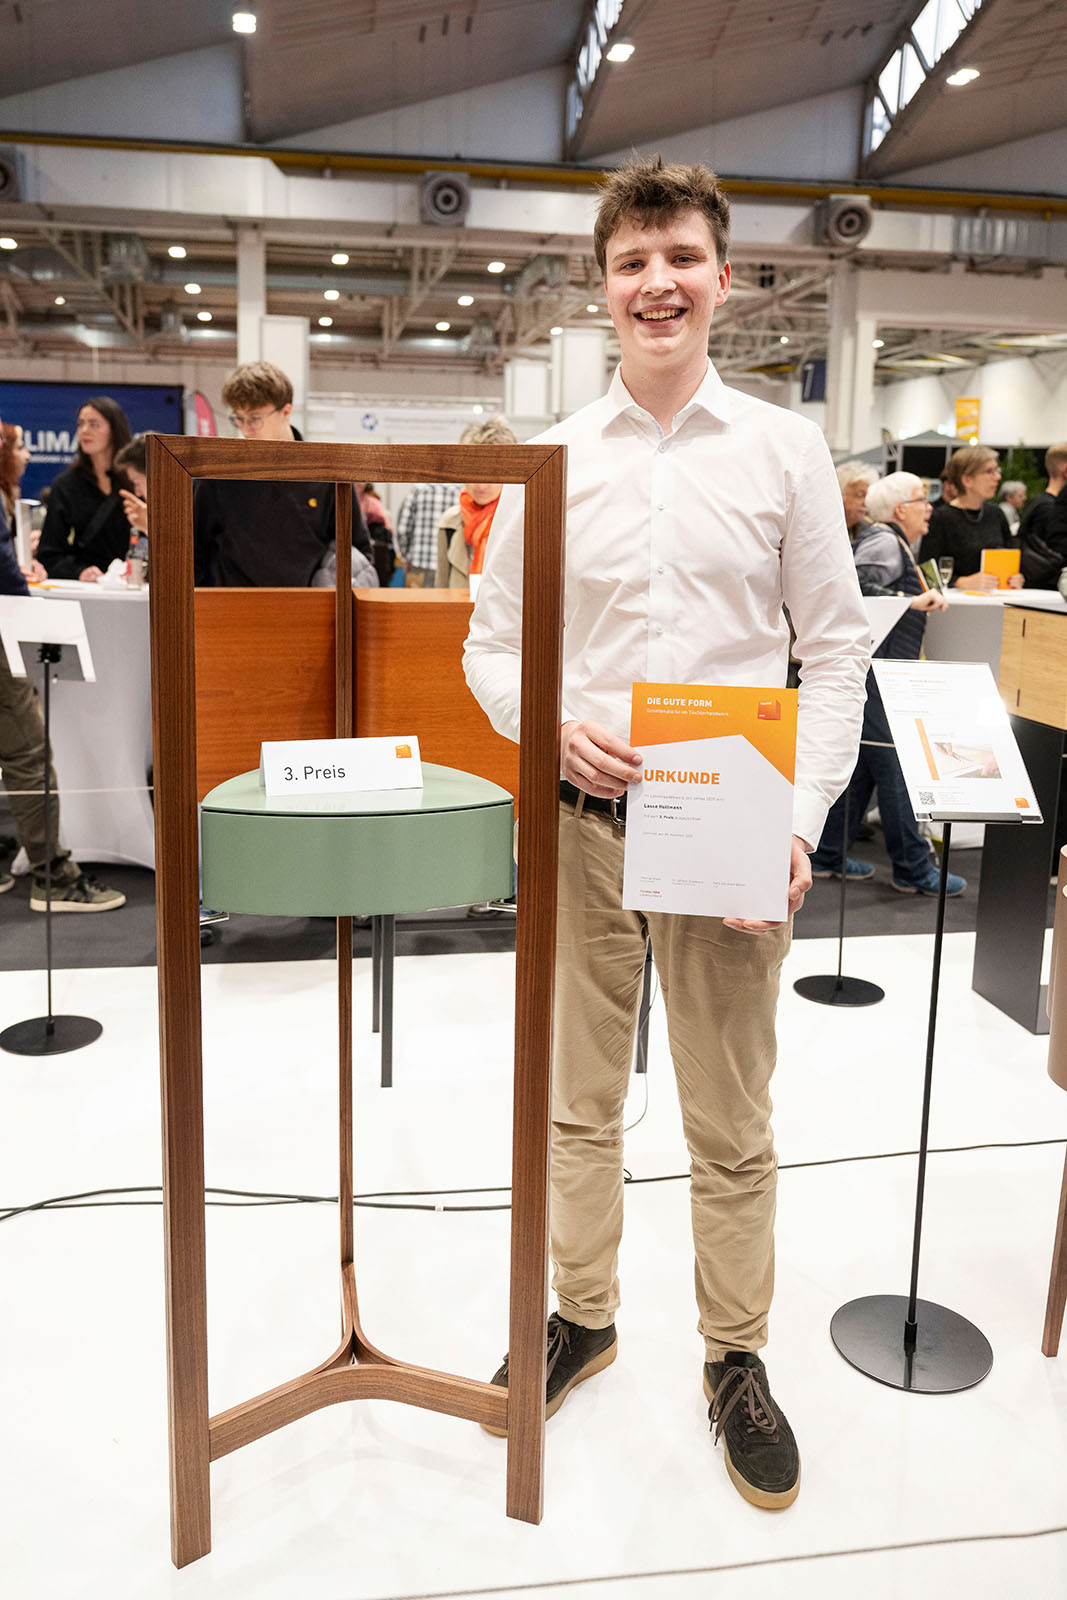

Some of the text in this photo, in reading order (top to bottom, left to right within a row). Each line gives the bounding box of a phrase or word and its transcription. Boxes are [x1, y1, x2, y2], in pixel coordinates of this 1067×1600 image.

[647, 697, 713, 707] DIE GUTE FORM
[284, 764, 346, 781] 3. Preis
[644, 769, 721, 785] URKUNDE
